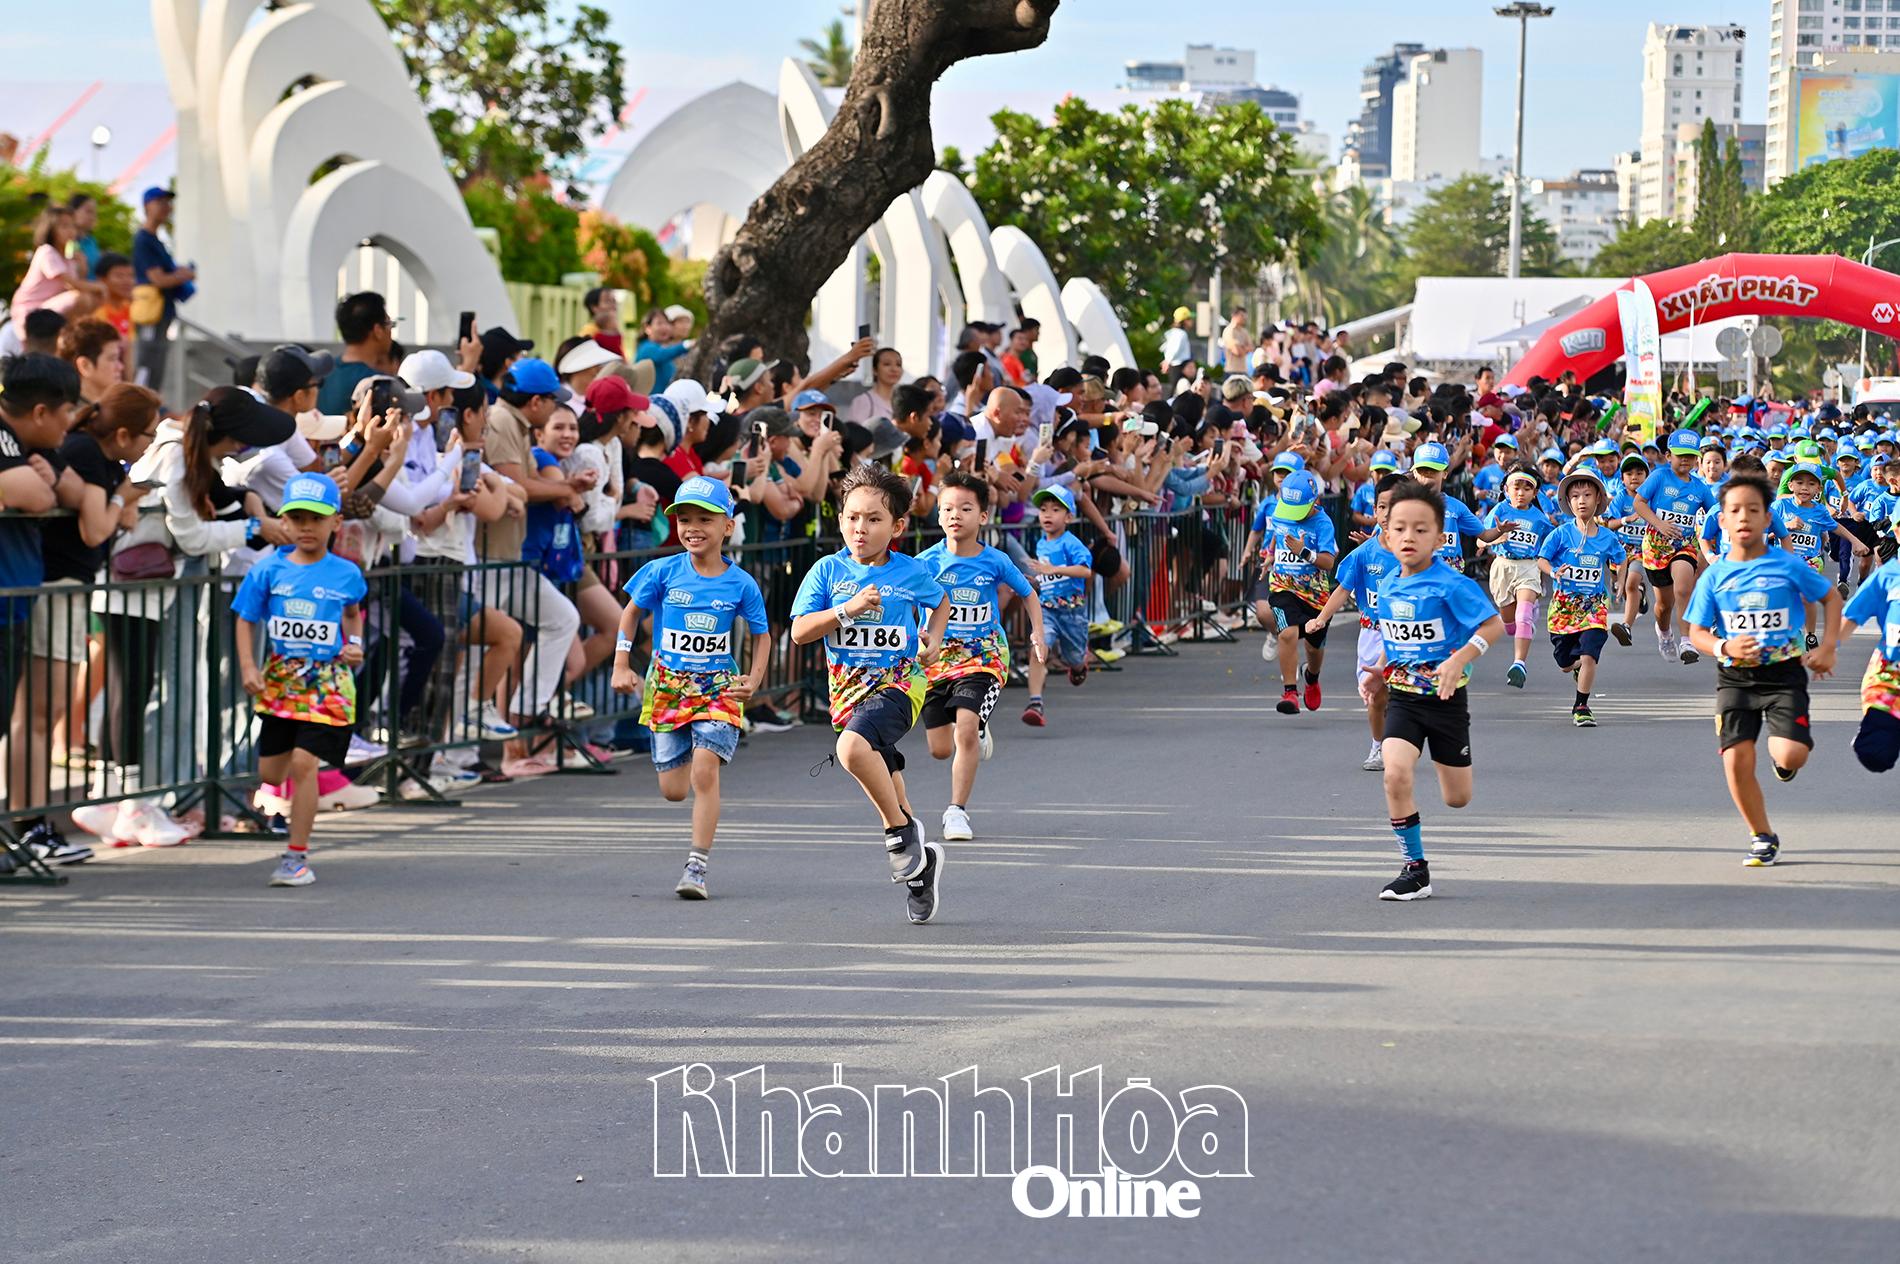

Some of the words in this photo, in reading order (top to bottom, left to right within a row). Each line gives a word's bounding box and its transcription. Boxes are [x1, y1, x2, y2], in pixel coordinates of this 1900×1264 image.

[1622, 525, 1646, 536] 1216
[1569, 567, 1601, 581] 1219
[947, 606, 989, 622] 2117
[273, 619, 329, 641] 12063
[834, 627, 901, 647] 12186
[1385, 622, 1435, 641] 12345
[670, 632, 727, 653] 12054
